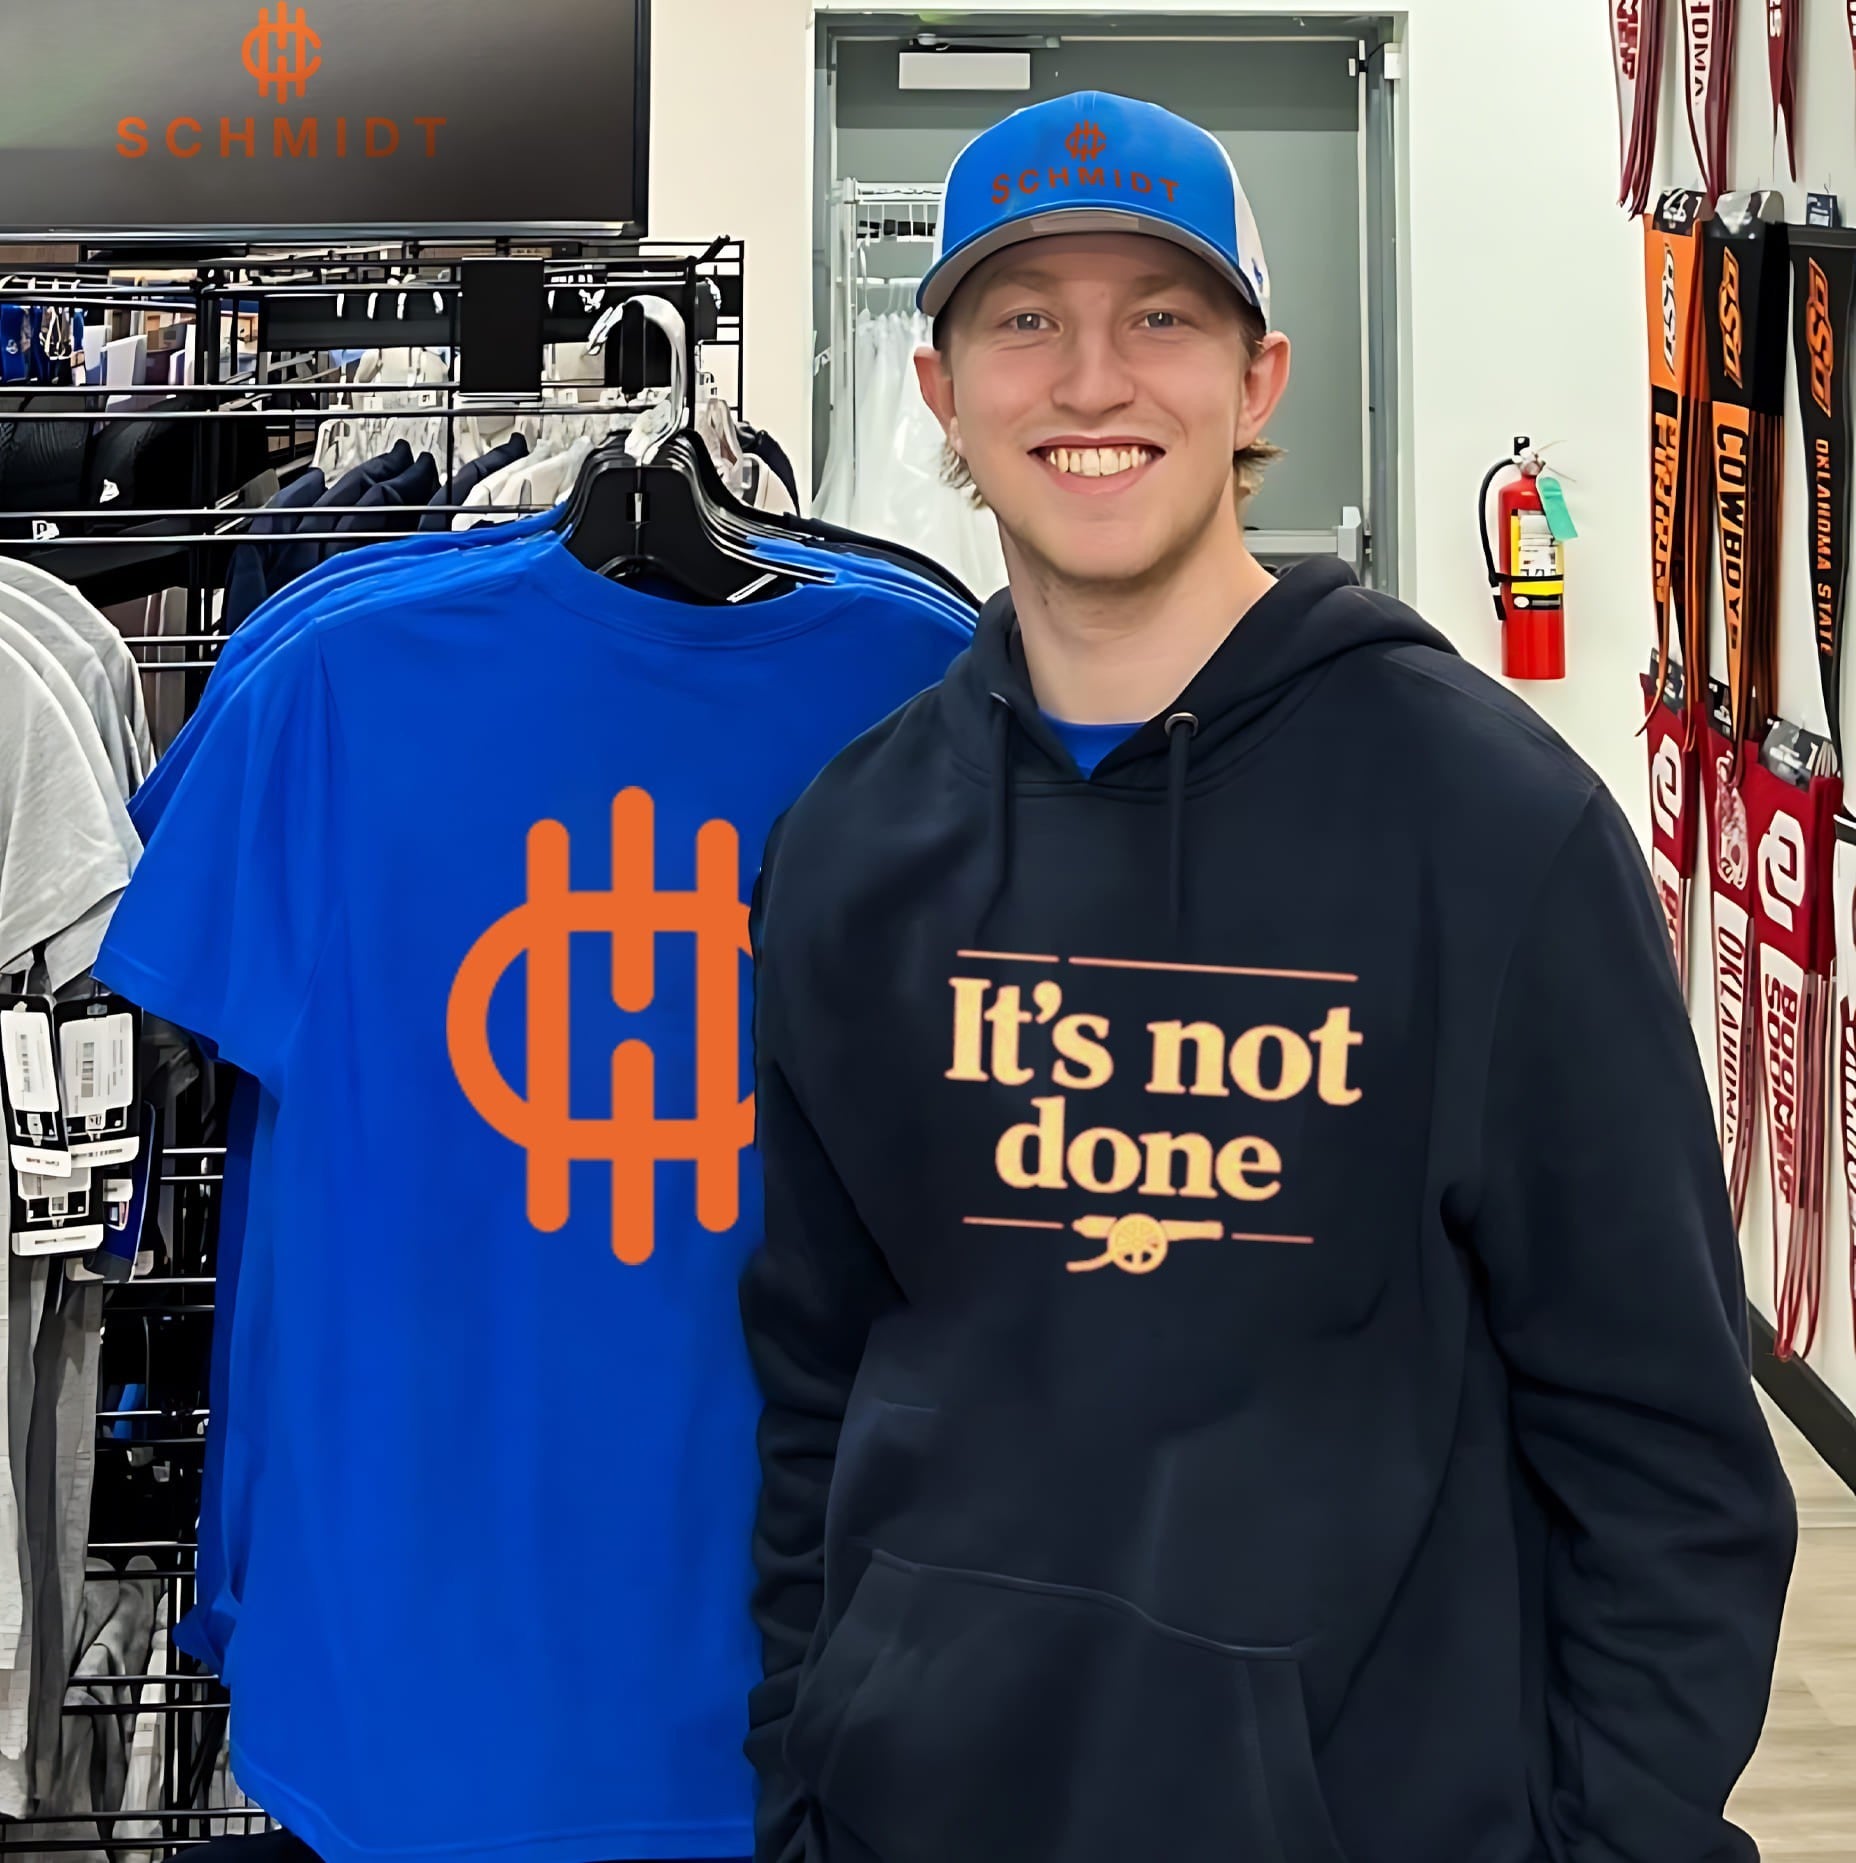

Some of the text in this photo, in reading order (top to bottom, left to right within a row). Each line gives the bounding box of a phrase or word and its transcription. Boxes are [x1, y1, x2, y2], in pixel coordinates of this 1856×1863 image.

[116, 116, 447, 158] SCHMIDT
[991, 166, 1179, 205] SCHMIDT
[1815, 438, 1832, 570] OKLAHOMA
[944, 977, 1363, 1106] It's not
[1718, 924, 1745, 1144] OKLAHOMA
[995, 1096, 1282, 1201] done
